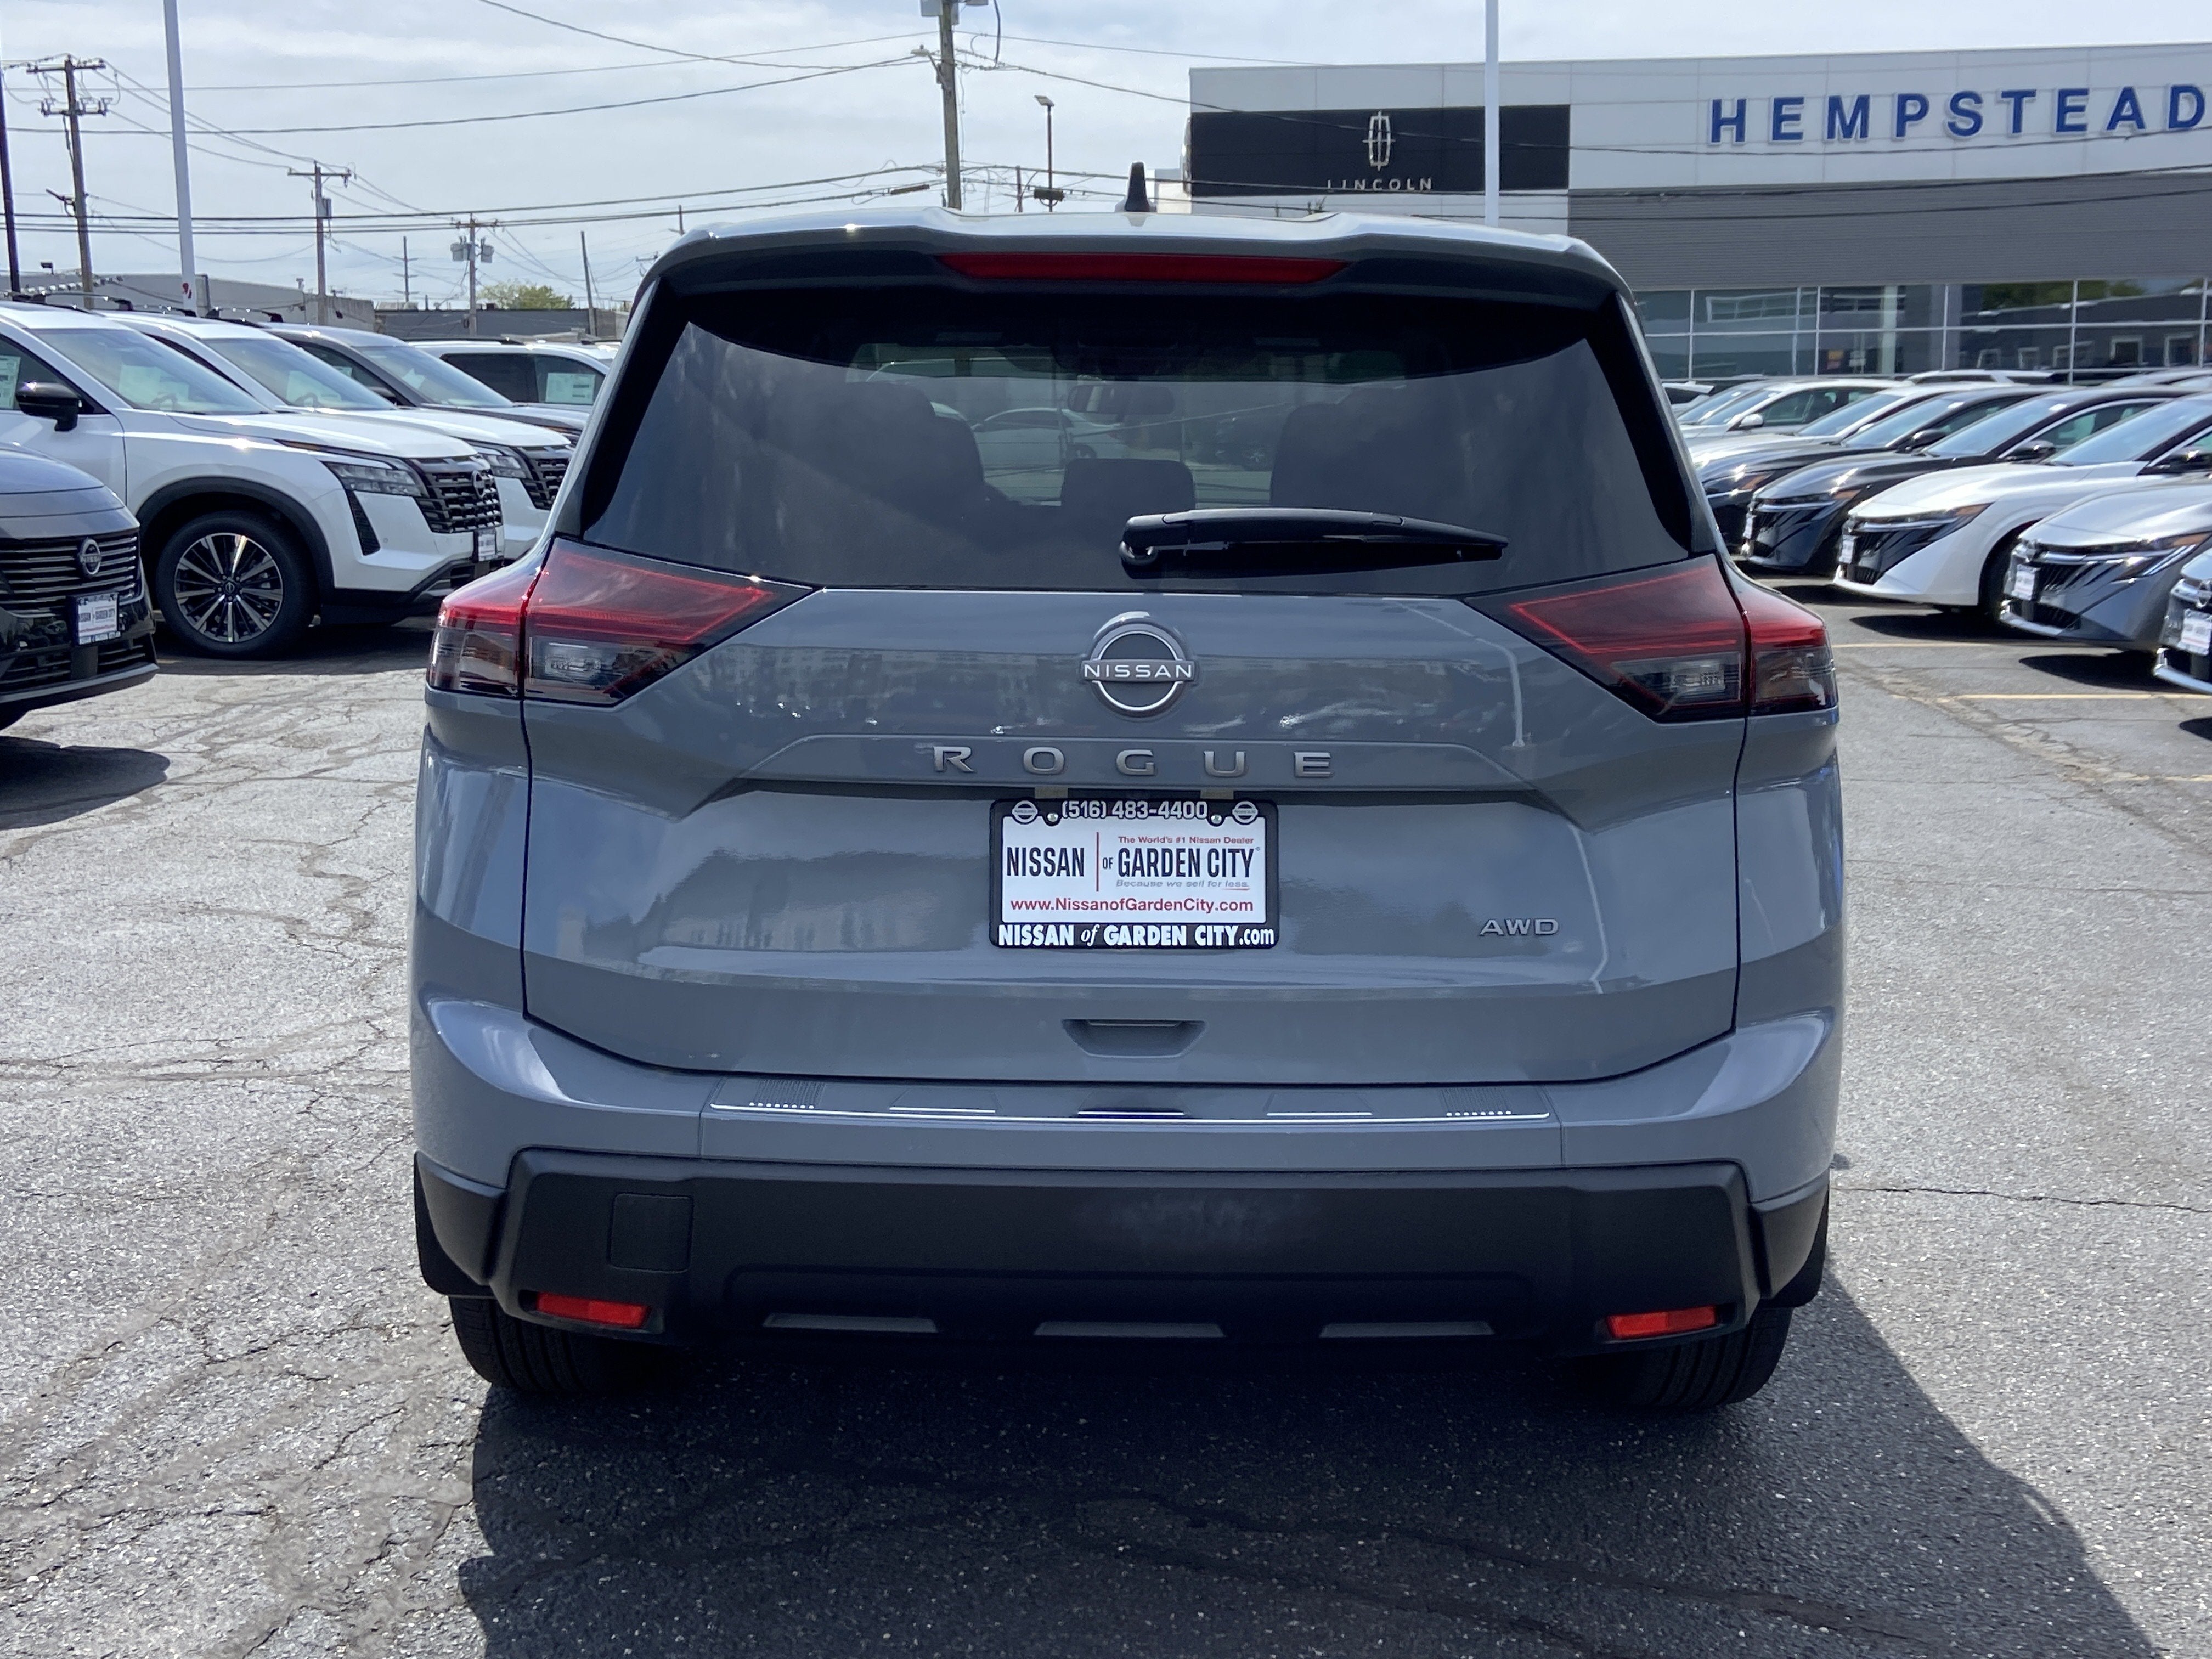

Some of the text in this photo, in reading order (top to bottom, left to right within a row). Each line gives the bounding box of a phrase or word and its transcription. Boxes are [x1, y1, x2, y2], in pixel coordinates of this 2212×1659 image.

[1709, 83, 2206, 144] HEMPSTEAD
[1327, 178, 1432, 192] LINCOLN
[1084, 663, 1193, 679] NISSAN
[933, 746, 1333, 778] ROGUE
[1062, 800, 1207, 819] (516) 483-4400
[1007, 847, 1254, 878] NISSAN OF GARDEN CITY
[1010, 898, 1254, 914] www.NissanofGardenCity.com
[998, 924, 1274, 946] NISSAN of GARDEN CITY.com
[1479, 918, 1559, 936] AWD
